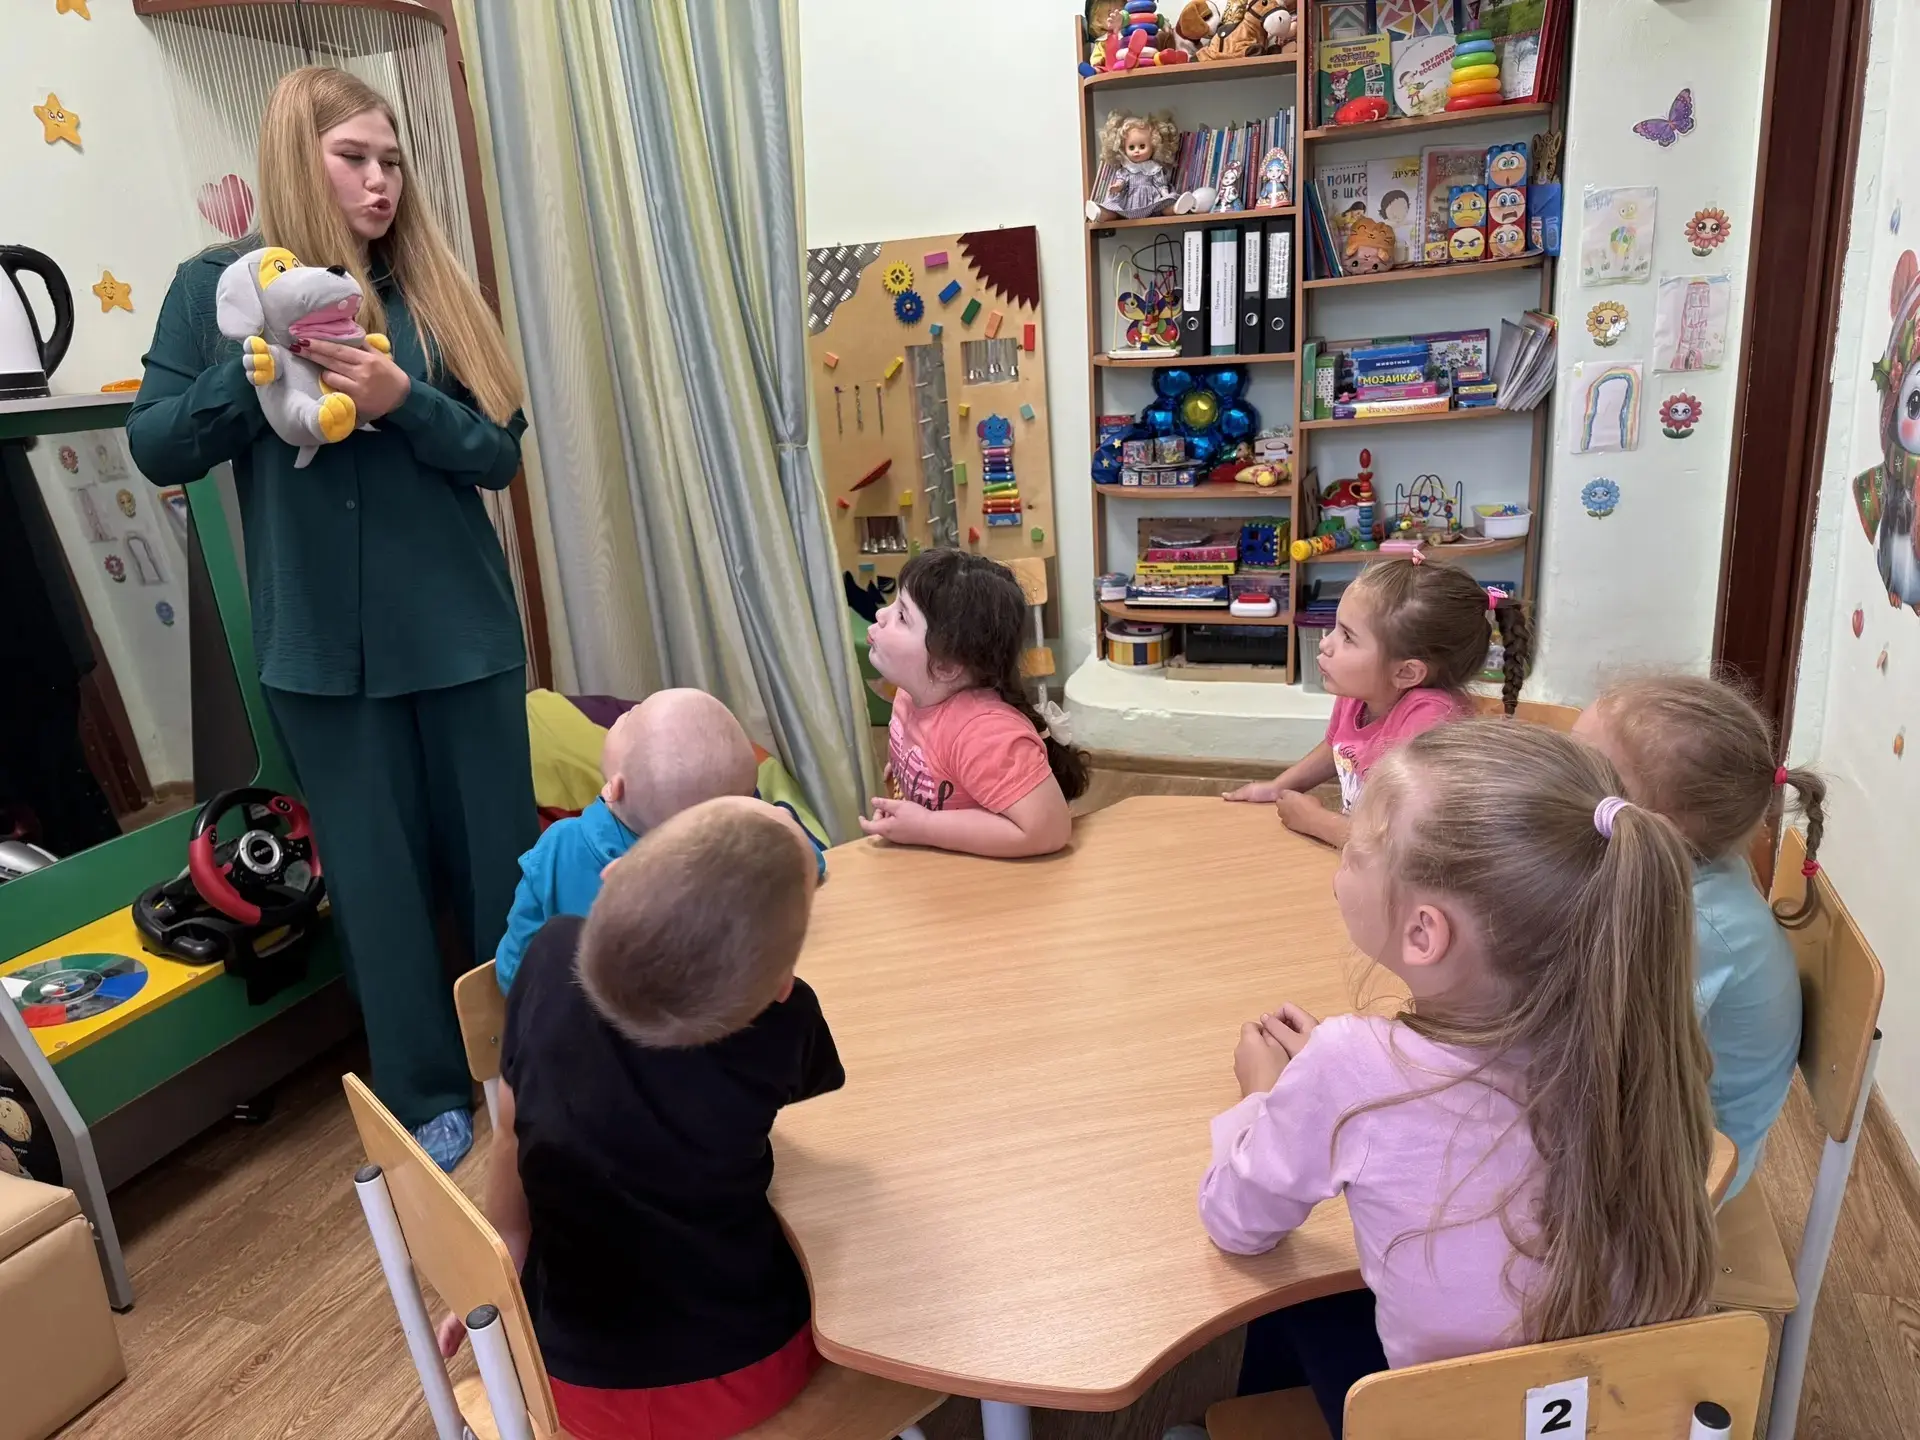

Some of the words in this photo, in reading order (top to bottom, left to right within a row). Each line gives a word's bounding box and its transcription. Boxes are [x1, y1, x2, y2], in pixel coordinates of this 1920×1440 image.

[1327, 172, 1367, 187] ПОИГР
[1363, 373, 1413, 385] МОЗАИКА
[1540, 1398, 1572, 1434] 2
